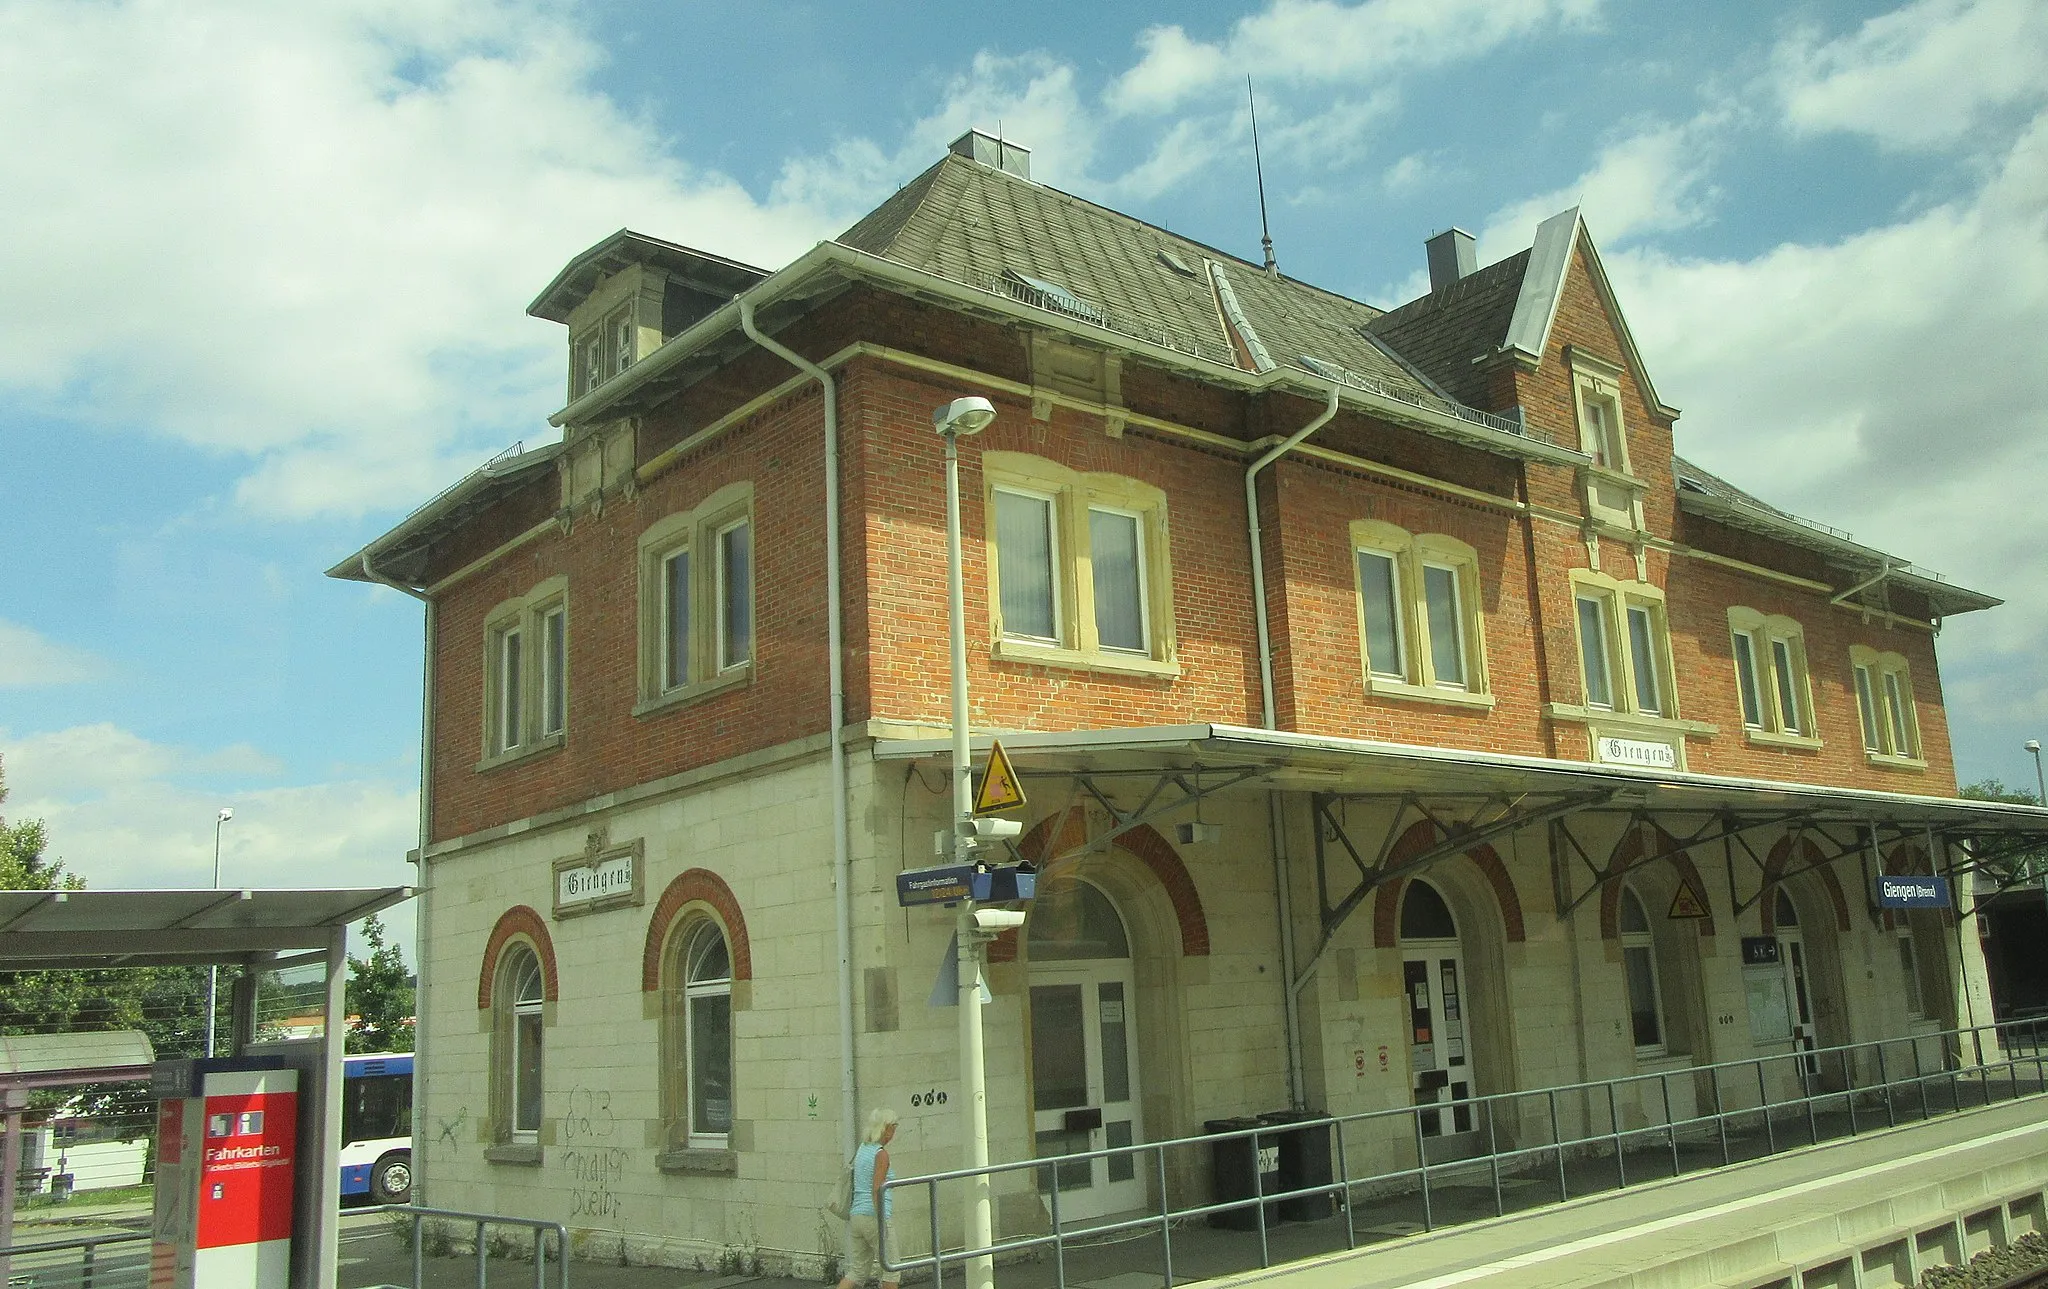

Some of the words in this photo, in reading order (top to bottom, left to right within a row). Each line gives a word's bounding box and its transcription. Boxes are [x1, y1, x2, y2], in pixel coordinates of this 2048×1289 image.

[1609, 739, 1665, 765] Giengen
[568, 869, 623, 895] Giengen
[1883, 881, 1917, 902] Giengen
[1916, 884, 1936, 898] (Brenz)
[206, 1145, 280, 1161] Fahrkarten
